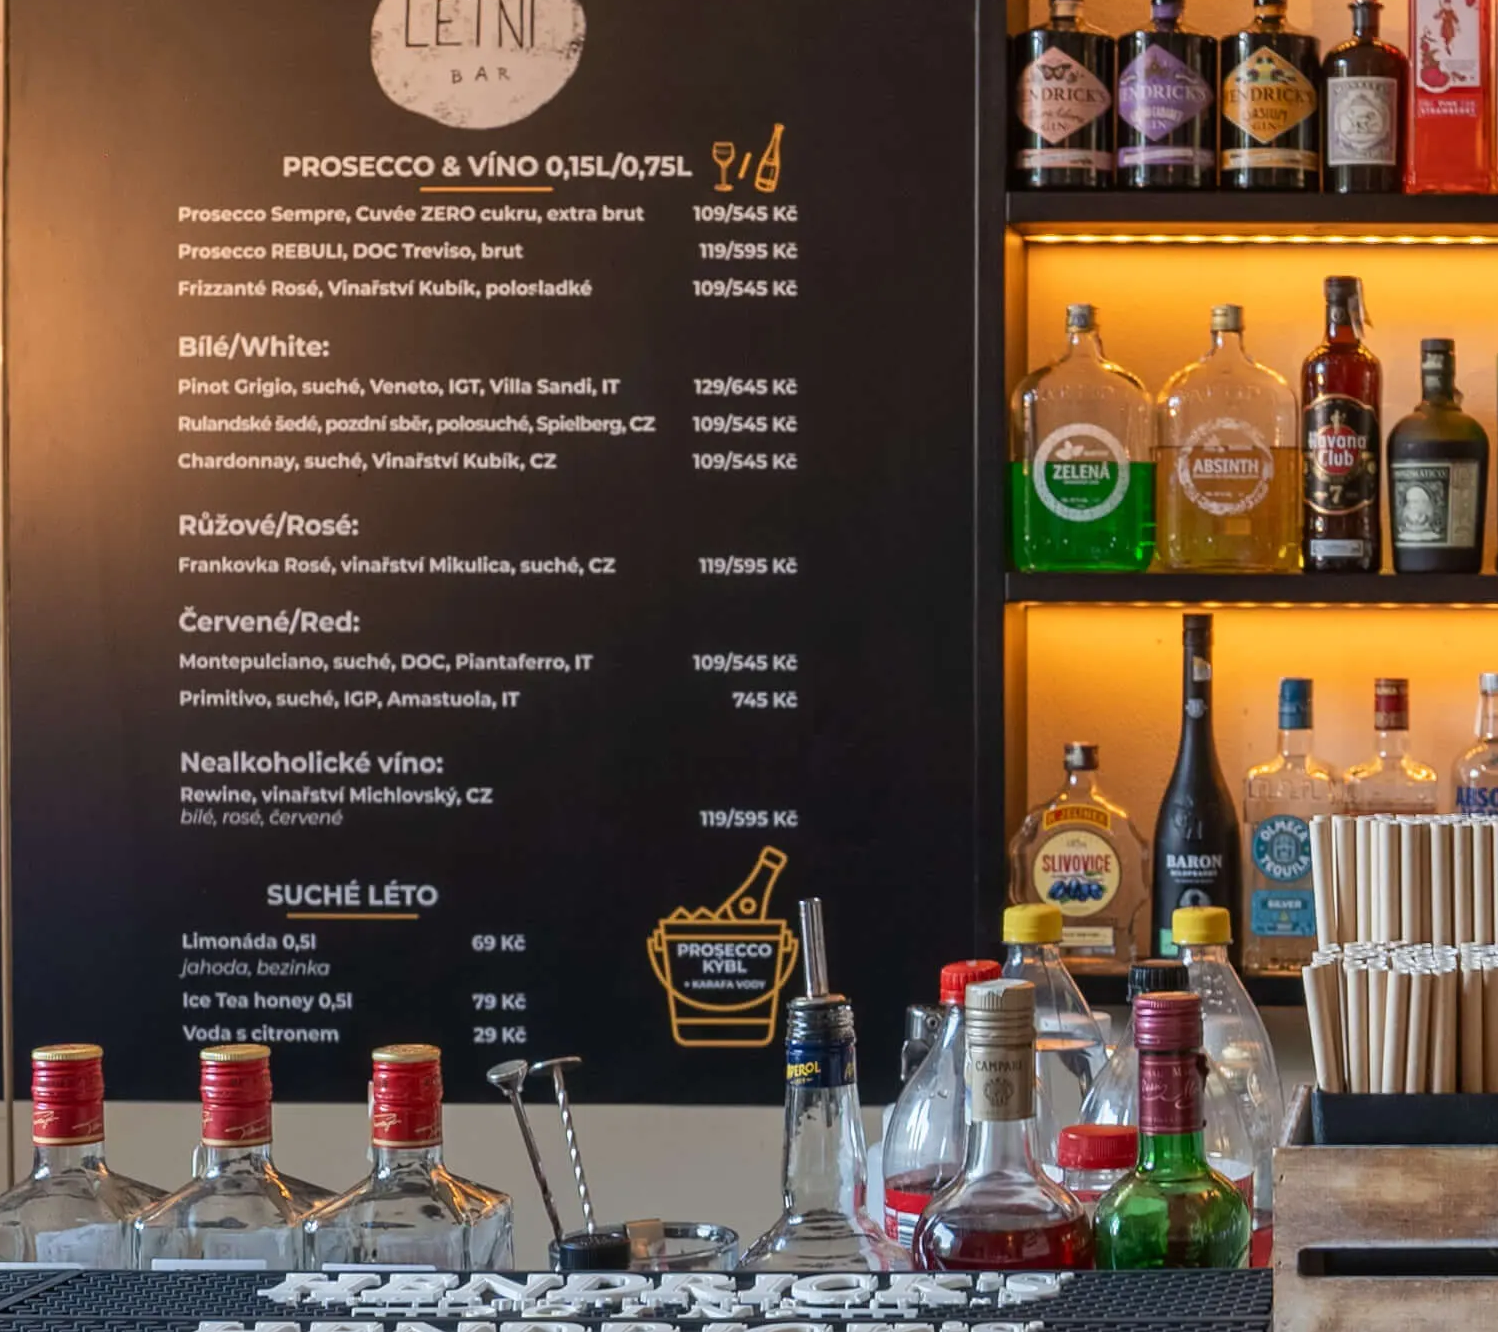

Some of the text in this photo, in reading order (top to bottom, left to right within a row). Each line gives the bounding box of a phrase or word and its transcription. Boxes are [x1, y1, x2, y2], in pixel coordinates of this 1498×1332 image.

[451, 66, 511, 85] BAR
[283, 150, 693, 181] PROSECCO & VÍNO 0,15L/0,75L
[178, 202, 798, 226] Prosecco Sempre, Cuvée ZERO cukru, extra brut 109/545 Kč
[178, 332, 330, 360] Bílé/White:
[178, 376, 798, 398] Pinot Grigio, suché, Veneto, IGT, Villa Sandi, IT 129/645 Kč
[1308, 432, 1367, 450] Havana
[1193, 458, 1259, 474] ABSINTH
[1318, 449, 1354, 467] Club
[1052, 461, 1110, 480] ZELENÁ
[1329, 485, 1343, 504] 7
[179, 510, 359, 539] Růžové/Rosé:
[178, 555, 617, 577] Frankovka Rosé, vinařství Mikulica, suché, CZ
[178, 605, 361, 635] Červené/Red:
[180, 750, 444, 774] Nealkoholické víno:
[1260, 819, 1308, 841] OLMECA
[1042, 854, 1111, 873] SLIVOVICE
[1166, 854, 1222, 869] BARON
[1259, 855, 1310, 878] TEQUILA
[267, 879, 439, 907] SUCHÉ LÉTO
[1268, 899, 1302, 909] SILVER
[181, 931, 526, 953] Limonáda 0,5l 69 Kč
[676, 942, 773, 958] PROSECCO
[702, 957, 748, 974] KÝBL
[975, 1060, 1023, 1073] CAMPARI
